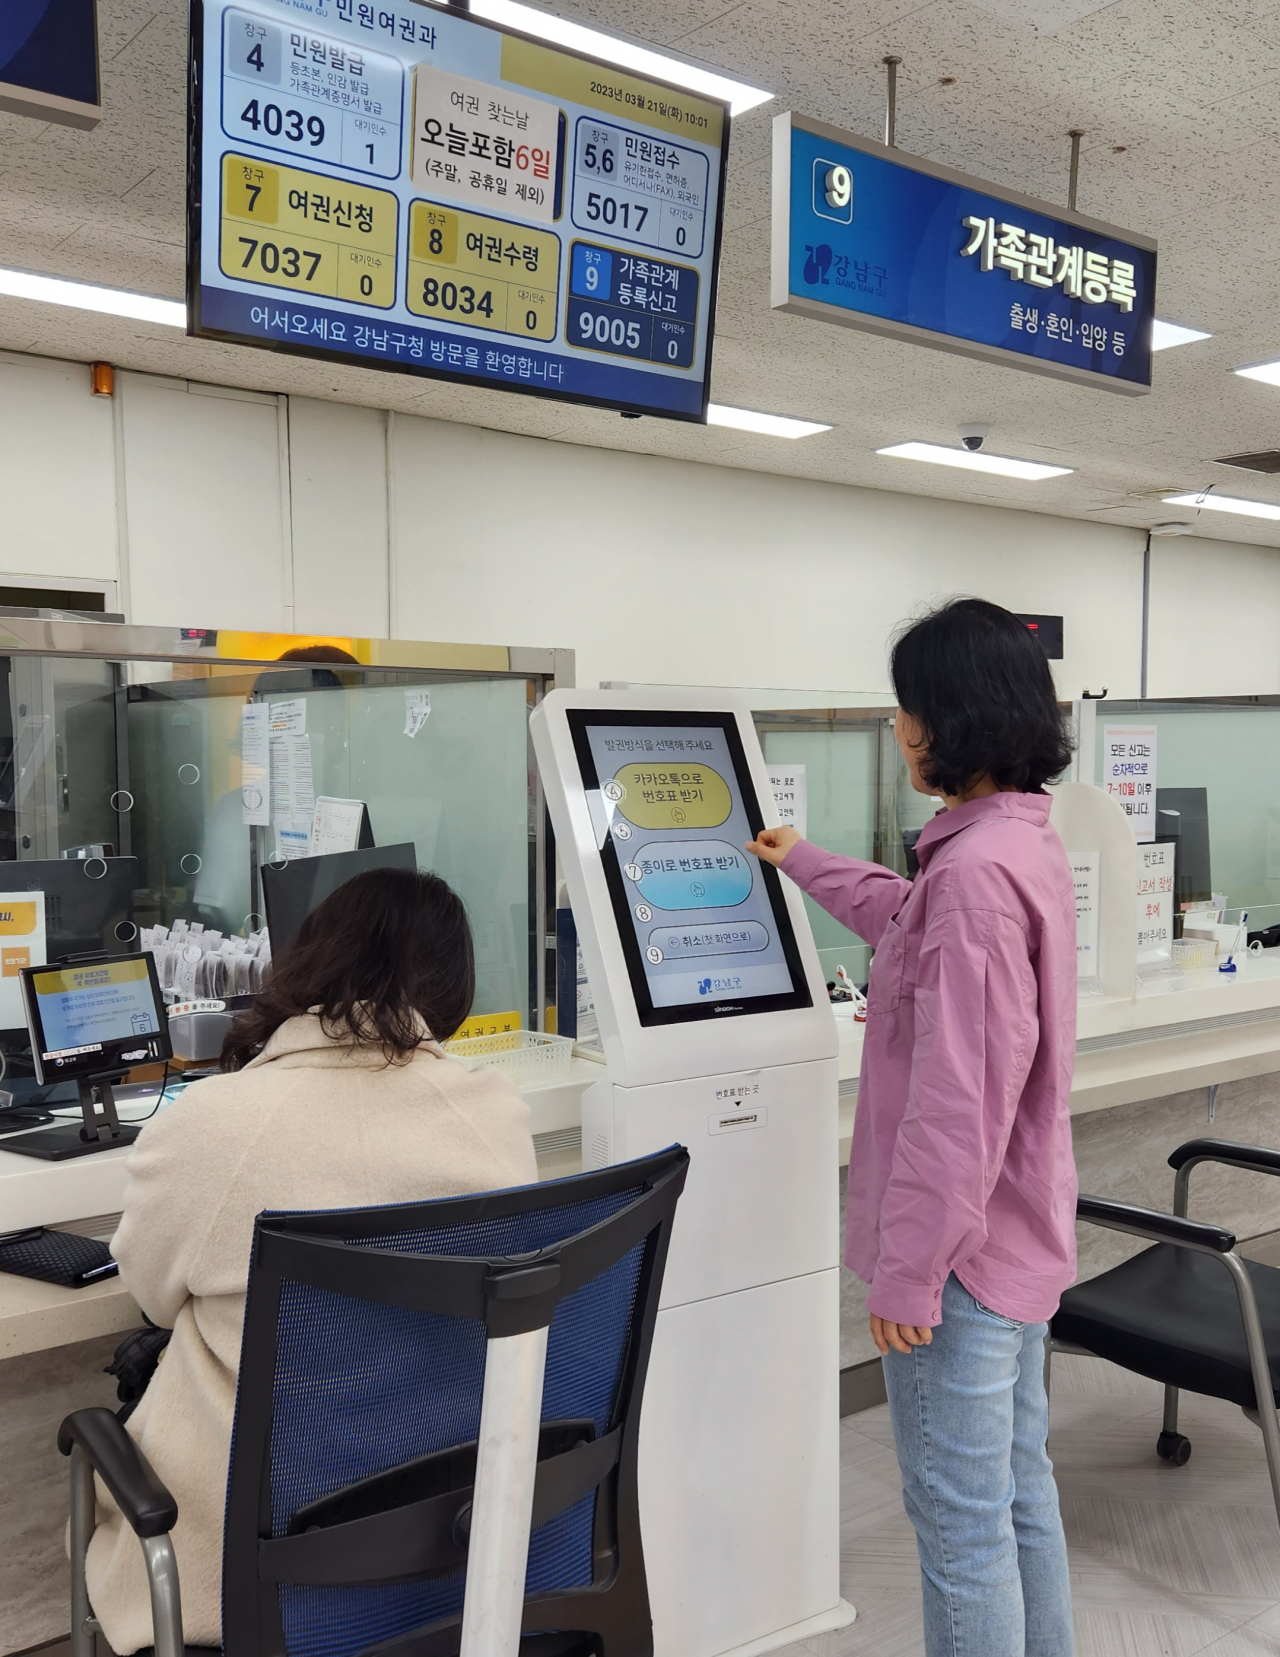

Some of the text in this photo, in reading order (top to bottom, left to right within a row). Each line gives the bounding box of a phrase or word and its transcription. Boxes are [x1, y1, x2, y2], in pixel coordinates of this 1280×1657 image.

[315, 7, 328, 17] GU
[244, 22, 268, 41] 창구
[336, 0, 437, 50] 민원여권과
[246, 43, 265, 73] 4
[290, 33, 365, 77] 민원발급
[290, 61, 369, 96] 등초본, 인감 발급
[290, 78, 382, 115] 가족관계증명서 발급
[590, 81, 708, 128] 2023년 03월 21일(화) 10:01
[450, 91, 530, 131] 여권 찾는날
[240, 98, 326, 147] 4039
[354, 119, 387, 137] 대기인수
[591, 129, 609, 144] 창구
[364, 143, 375, 165] 1
[584, 143, 615, 175] 5,6
[625, 136, 680, 170] 민원접수
[242, 166, 265, 183] 창구
[425, 157, 545, 206] (주말, 공휴일 제외)
[624, 161, 690, 190] 유기한접수, 면허증,
[245, 183, 262, 212] 7
[623, 174, 699, 206] 어디서나(FAX), 외국인
[825, 166, 851, 208] 9
[288, 189, 374, 234] 여권신청
[427, 211, 447, 227] 창구
[586, 192, 649, 232] 5017
[669, 207, 694, 222] 대기인수
[428, 228, 444, 255] 8
[675, 226, 687, 246] 0
[238, 236, 323, 282] 7037
[350, 252, 383, 269] 대기인수
[465, 232, 540, 273] 여권수령
[584, 250, 602, 265] 창구
[618, 257, 680, 291] 가족관계
[833, 254, 889, 288] 강남구
[959, 215, 1137, 314] 가족관계등록
[359, 274, 374, 297] 0
[585, 266, 599, 292] 9
[835, 277, 887, 298] GANG NAM GU
[422, 277, 494, 319] 8034
[517, 289, 546, 305] 대기인수
[617, 282, 678, 314] 등록신고
[525, 310, 538, 331] 0
[578, 311, 642, 350] 9005
[661, 322, 686, 336] 대기인수
[250, 306, 565, 385] 어서오세요 강남구청 방문을 환영합니다
[667, 340, 679, 360] 0
[1111, 330, 1126, 357] 등
[604, 738, 714, 752] 발권방식을 선택해 주세요
[1110, 744, 1151, 757] 모든 신고는
[633, 772, 705, 787] 카카오톡으로
[1112, 763, 1149, 776] 순차적으로
[642, 789, 704, 804] 번호표 받기
[1107, 782, 1152, 796] 7~10일 이후
[641, 855, 740, 876] 종이로 번호표 받기
[1143, 851, 1165, 868] 번호표
[628, 865, 638, 879] 7
[1159, 875, 1173, 892] 작성
[639, 906, 649, 921] 8
[1145, 901, 1161, 920] 후에
[682, 931, 751, 948] 취소(첫 화면으로)
[650, 948, 660, 962] 9
[713, 977, 741, 988] 강남구
[139, 1023, 147, 1032] 6
[715, 1084, 760, 1100] 번호표 받는 곳
